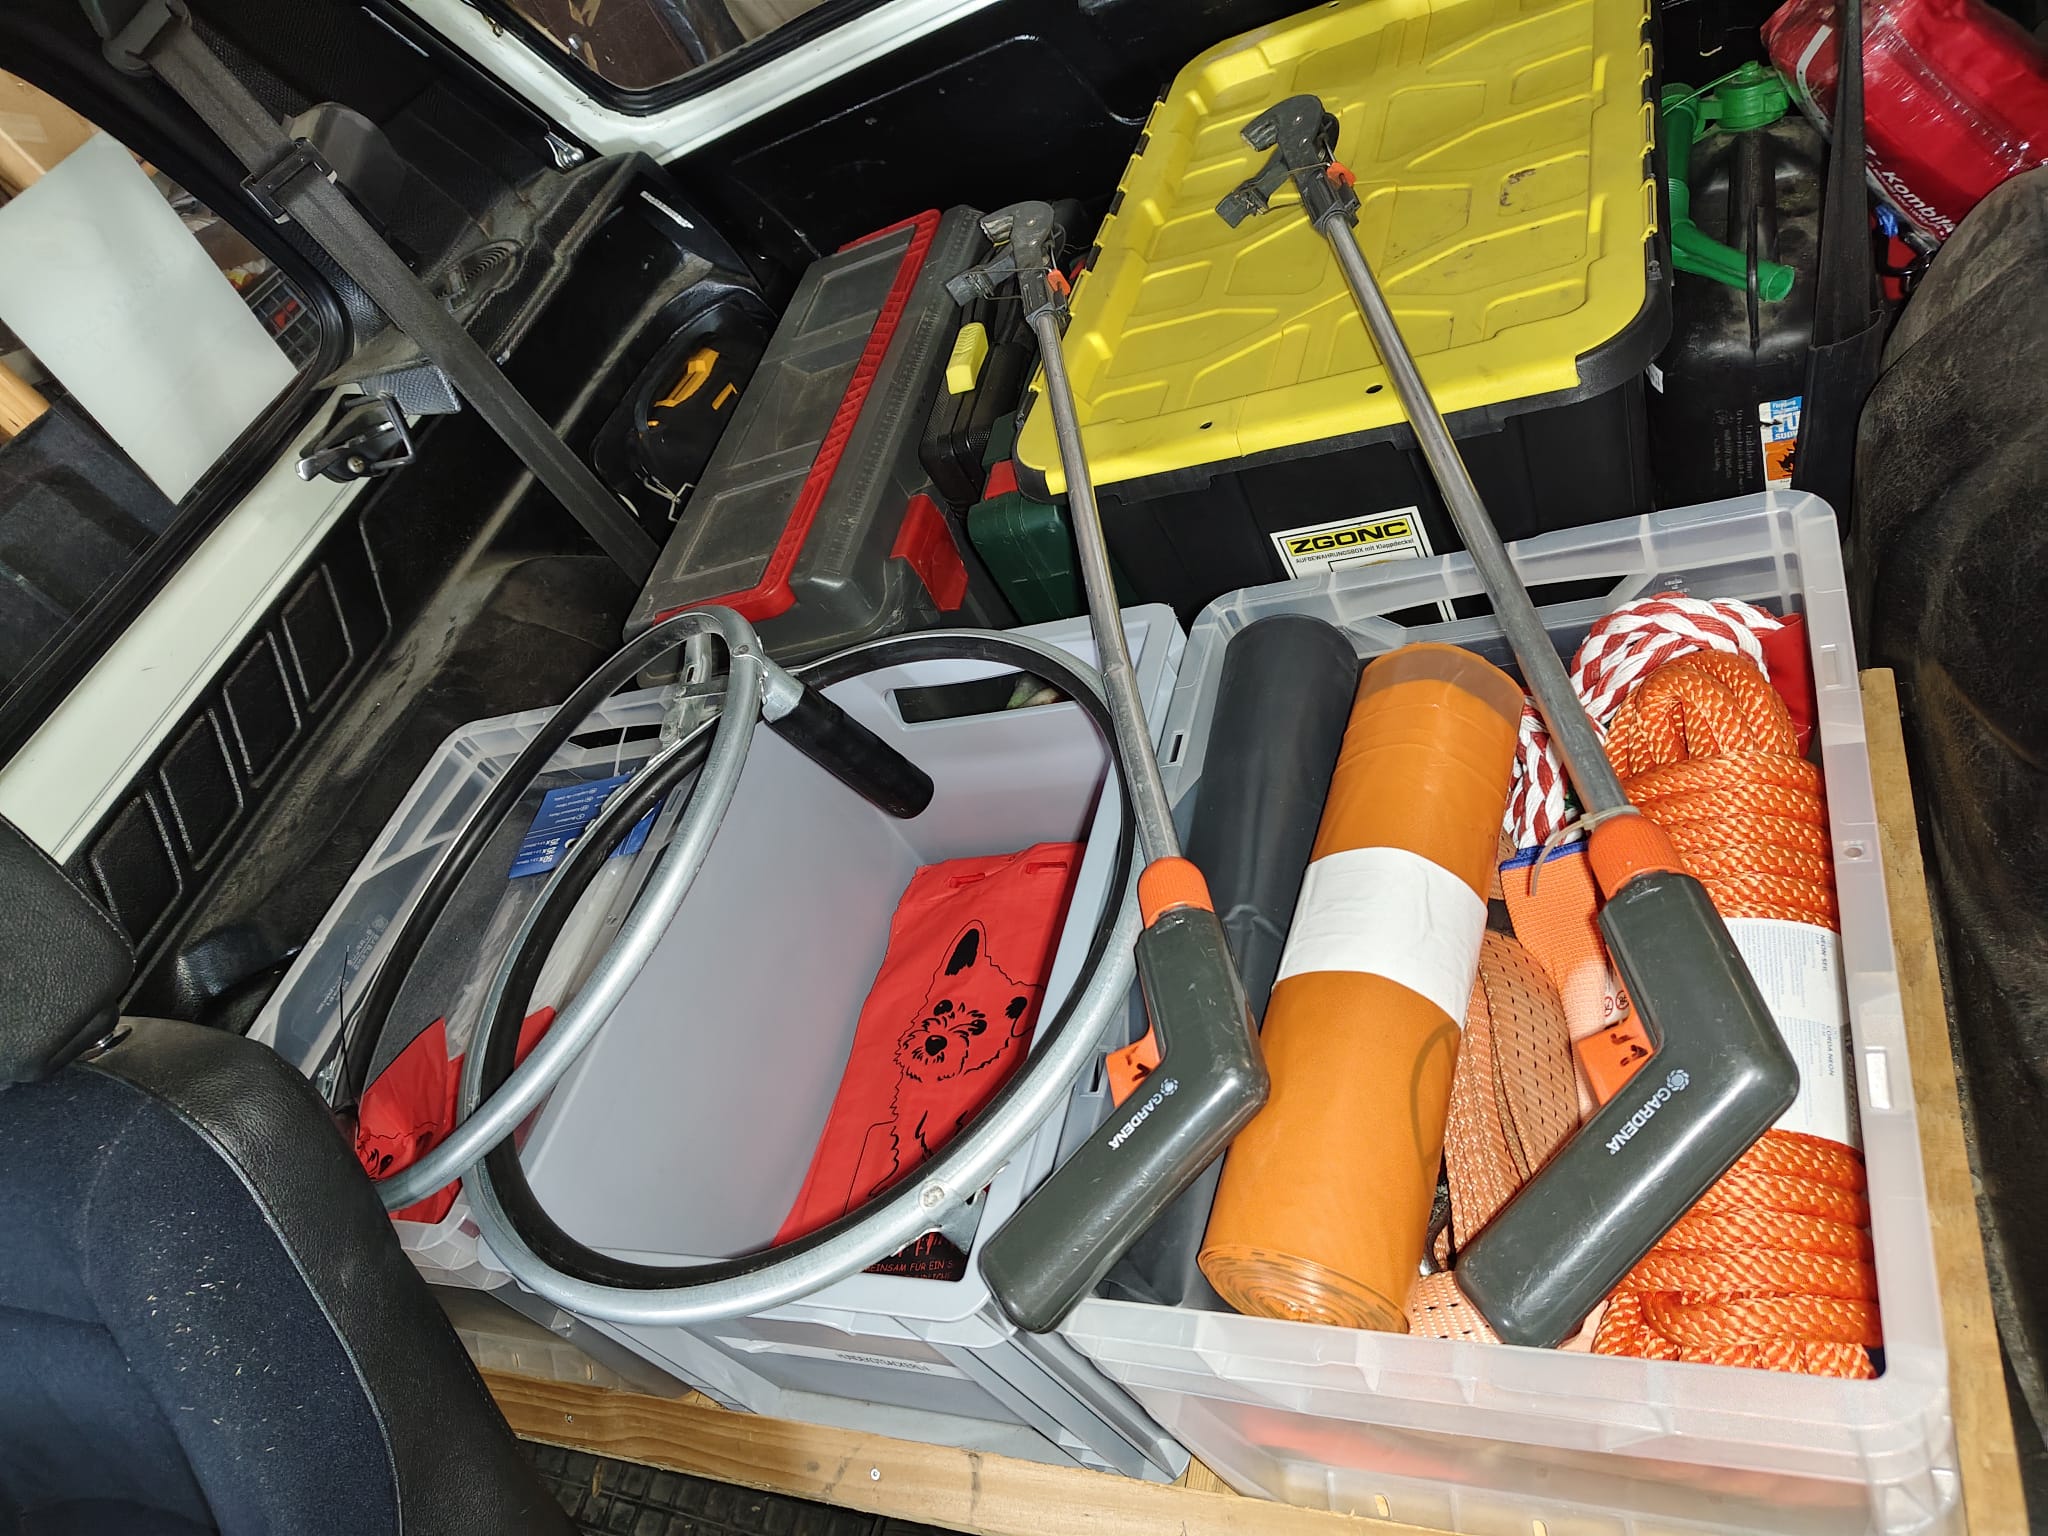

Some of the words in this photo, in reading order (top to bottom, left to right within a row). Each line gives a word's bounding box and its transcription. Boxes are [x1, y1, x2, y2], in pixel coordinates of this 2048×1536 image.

[1289, 522, 1408, 554] ZGONC
[1296, 547, 1364, 563] AUFBEWAHRUNGSBOX
[1364, 544, 1375, 553] mit
[1375, 538, 1414, 551] Klappdeckel
[1108, 1093, 1163, 1150] GARDENA
[1605, 1087, 1671, 1154] GARDENA
